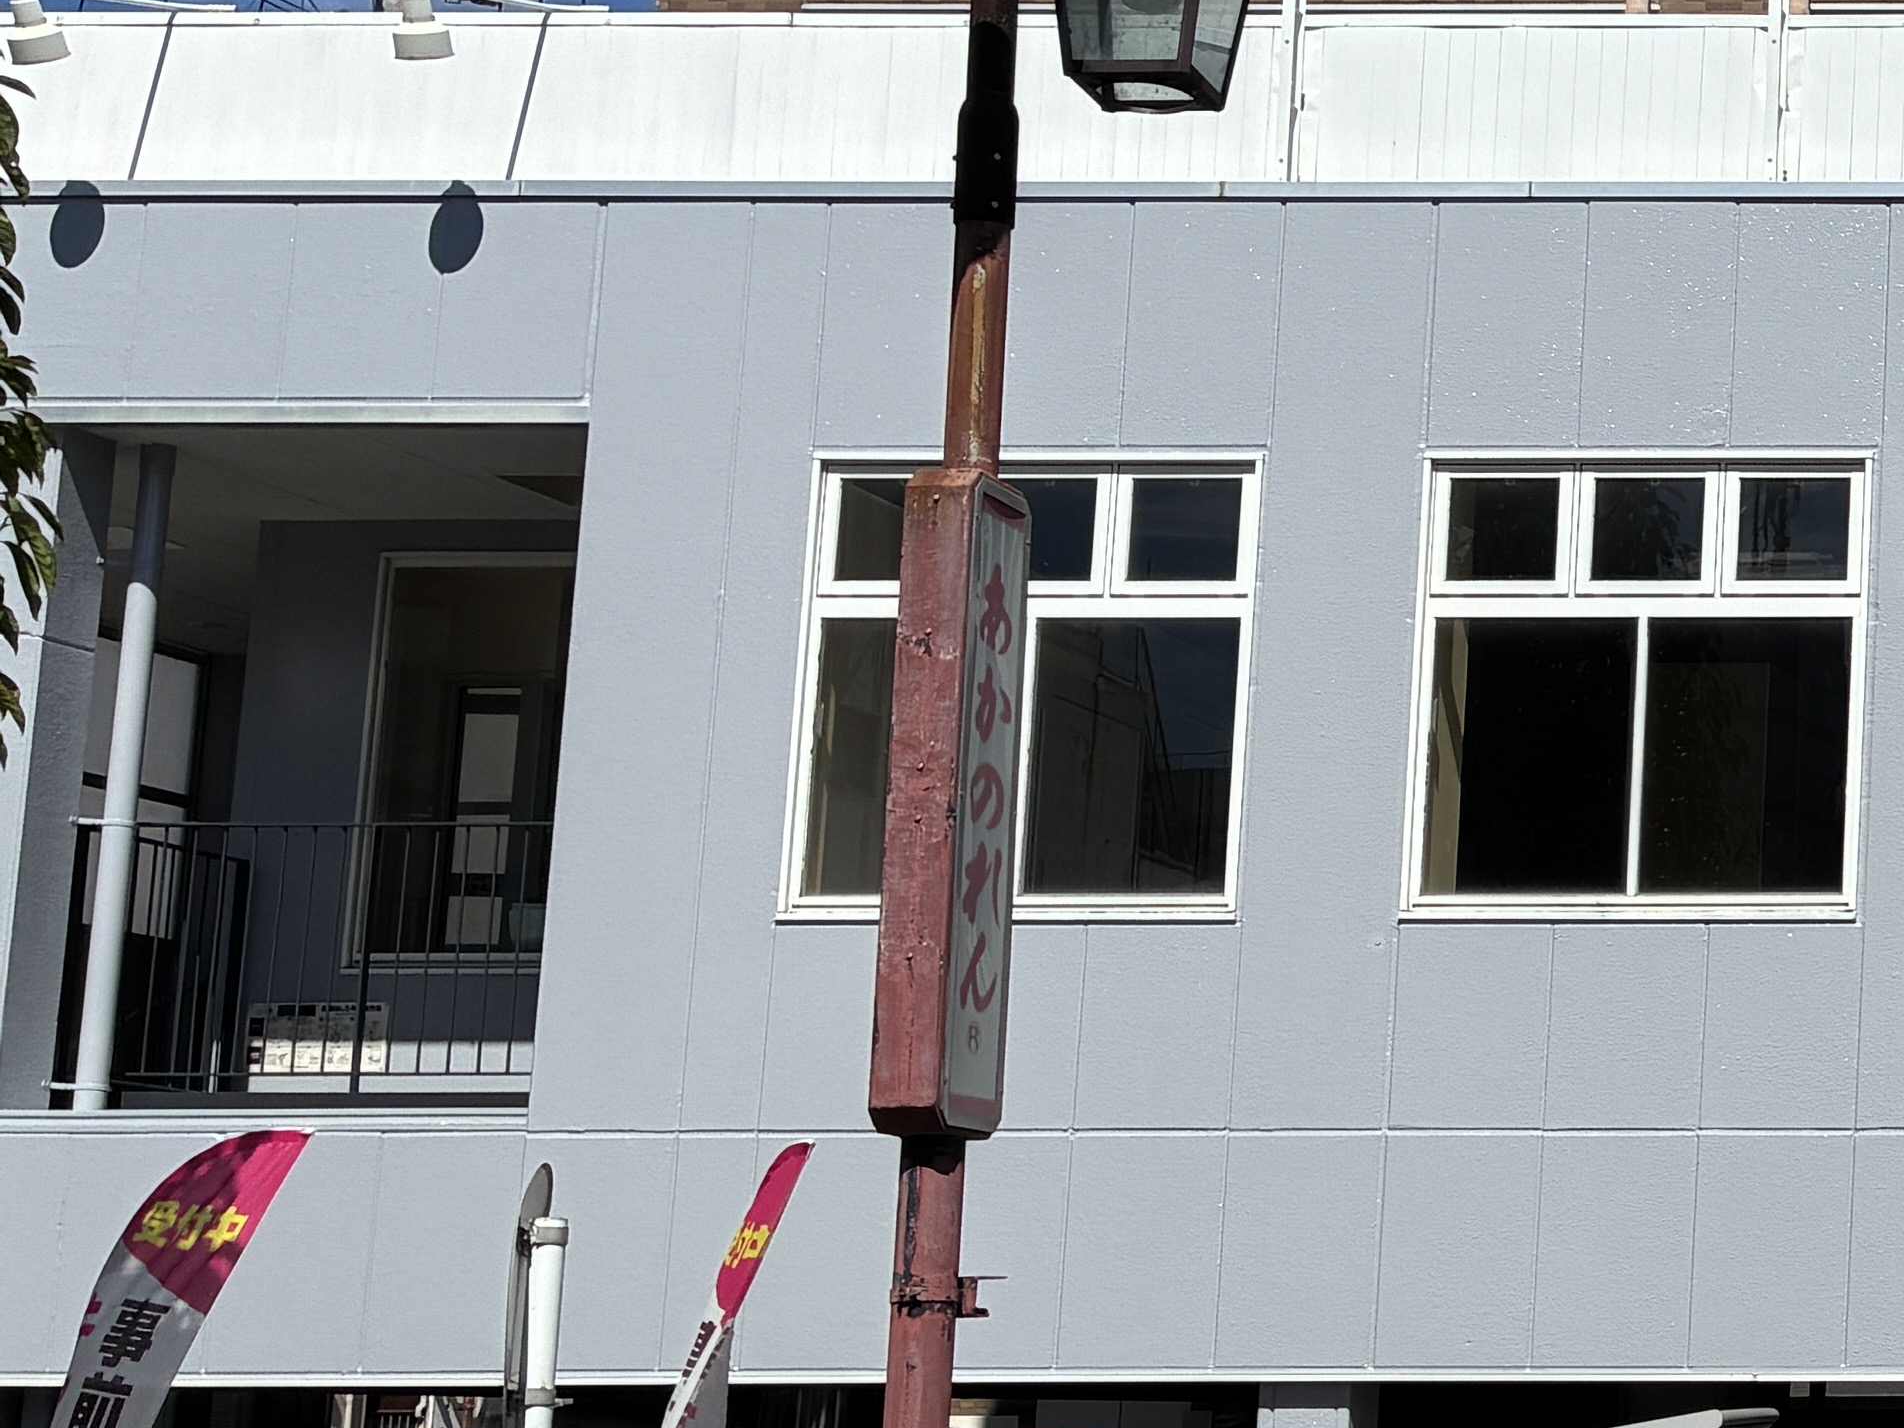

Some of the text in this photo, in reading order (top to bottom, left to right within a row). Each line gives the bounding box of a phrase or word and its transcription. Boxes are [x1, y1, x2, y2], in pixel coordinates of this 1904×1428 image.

[960, 564, 1012, 1014] あかのれん
[132, 1200, 249, 1252] 受付中
